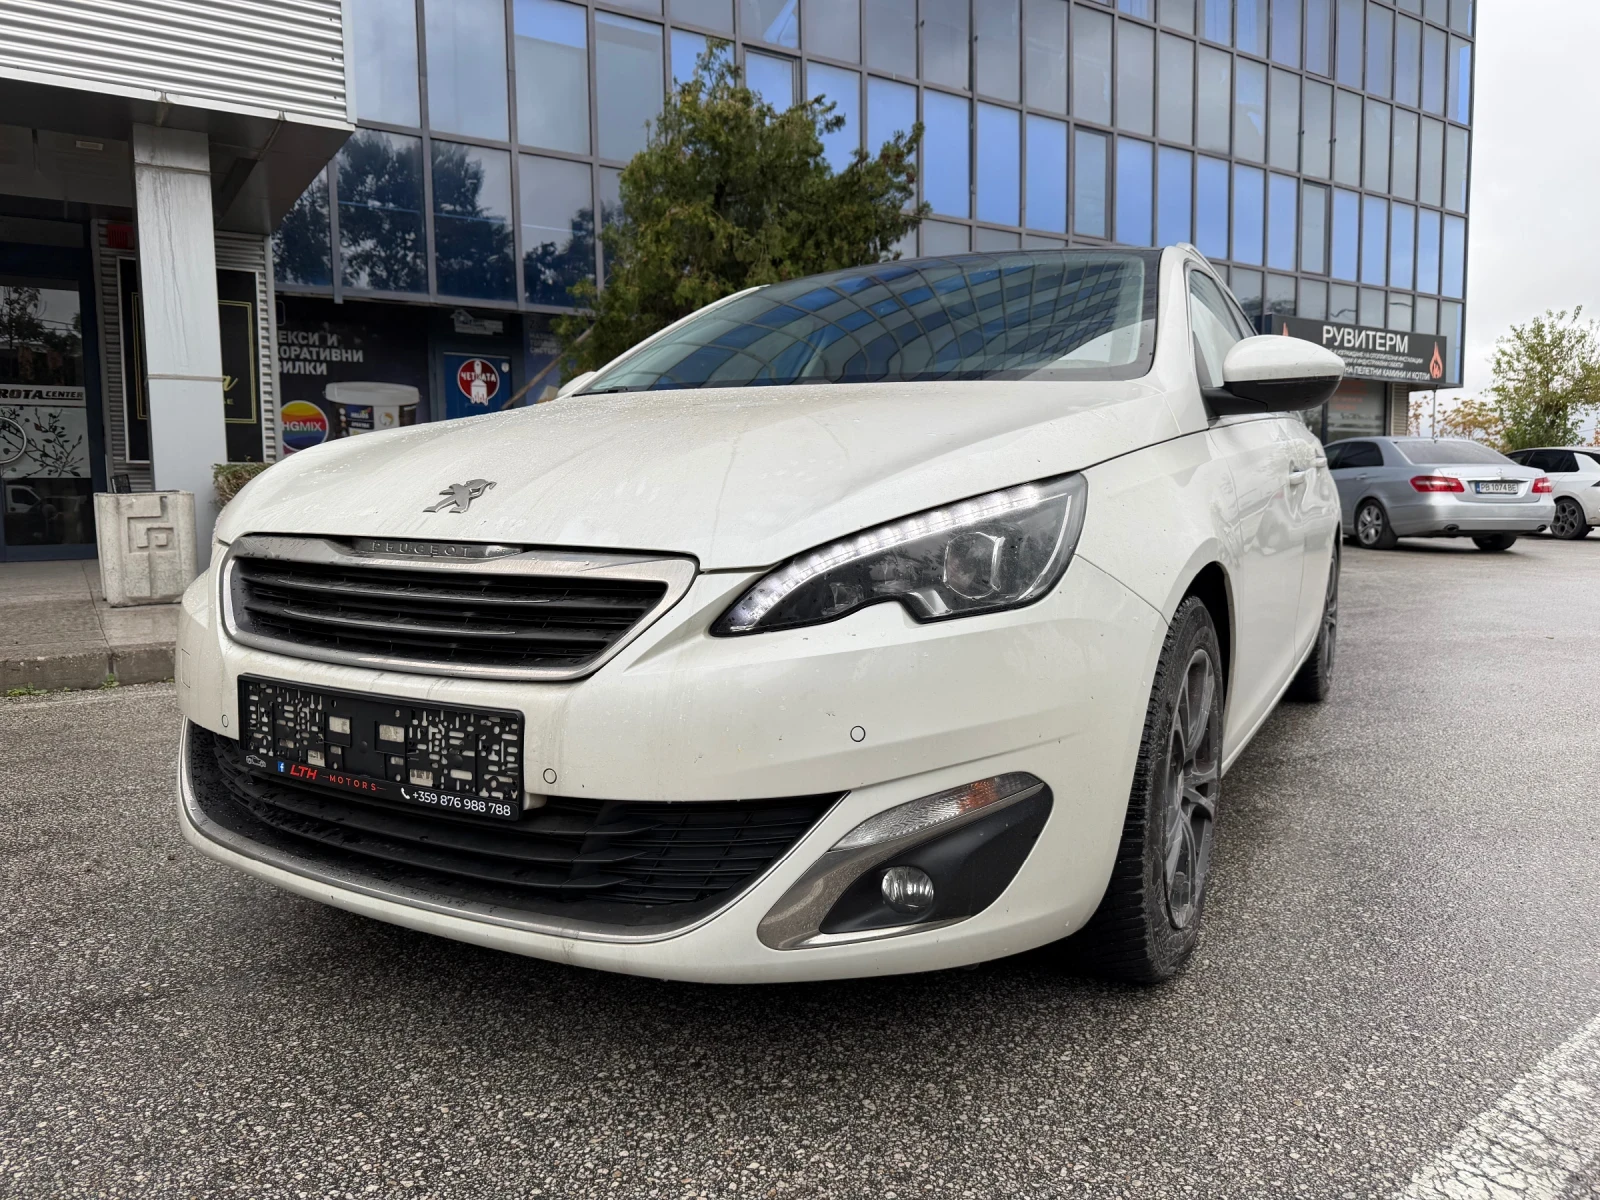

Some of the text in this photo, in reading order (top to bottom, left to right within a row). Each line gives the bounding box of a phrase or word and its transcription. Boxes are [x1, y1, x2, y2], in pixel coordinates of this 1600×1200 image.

[327, 333, 338, 346] И
[1322, 325, 1408, 353] РУВИТЕРМ
[1354, 366, 1382, 376] ПЕЛЕТНИ
[1382, 368, 1406, 378] КАМИНИ
[1412, 371, 1430, 380] КОТЛИ
[1491, 482, 1507, 490] 1074
[371, 541, 472, 557] PEUGEOT
[290, 764, 318, 780] LTH
[329, 774, 377, 791] MOTORS
[412, 791, 511, 816] +359 876 988 788
